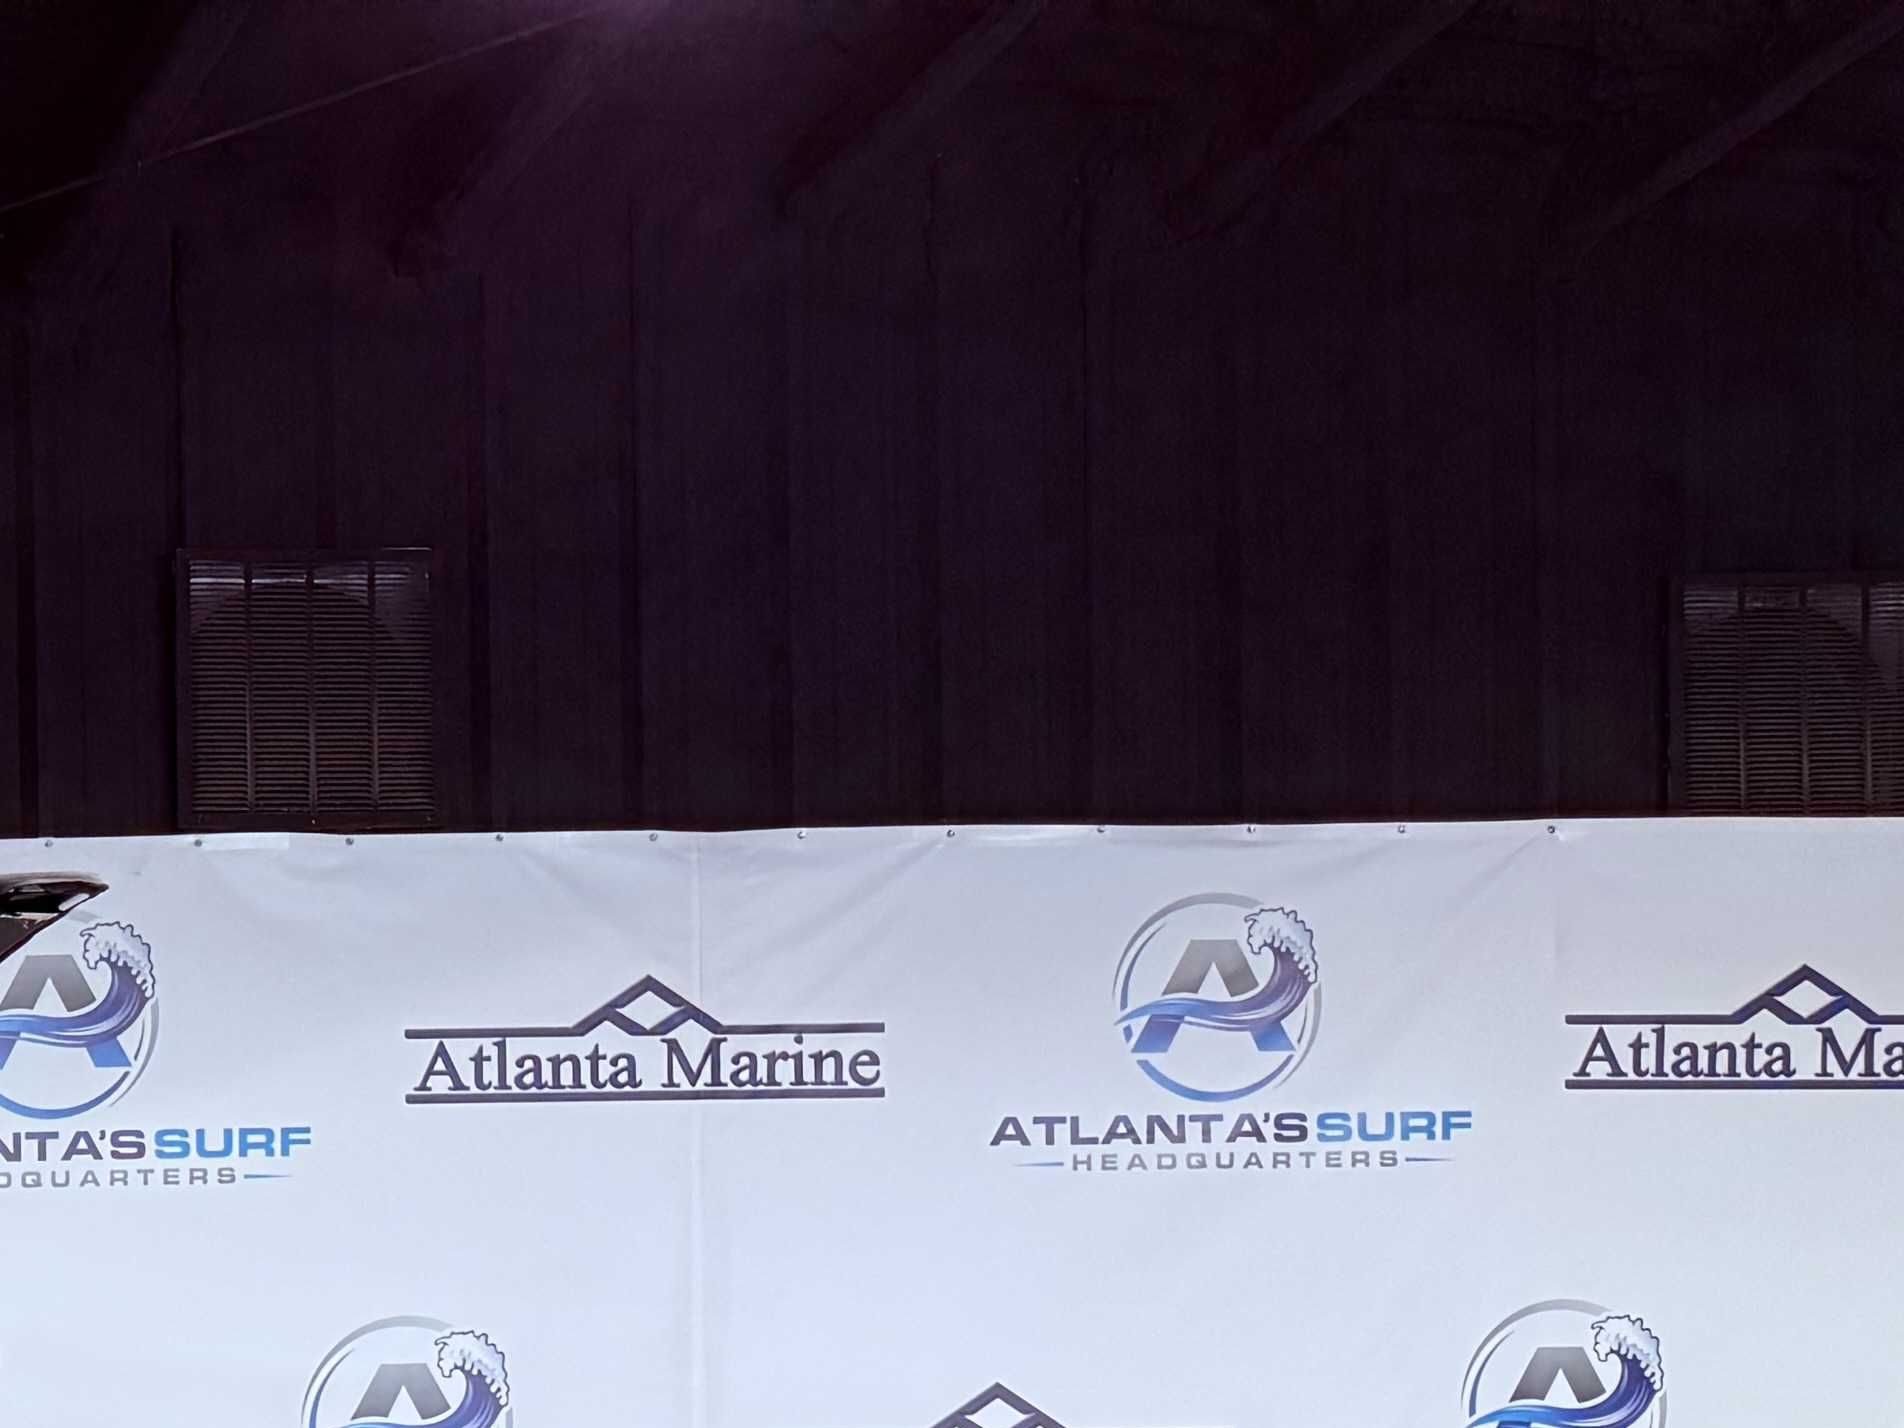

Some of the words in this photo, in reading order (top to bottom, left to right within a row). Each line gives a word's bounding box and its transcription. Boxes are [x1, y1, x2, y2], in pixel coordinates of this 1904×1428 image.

[413, 1037, 643, 1092] Atlanta
[658, 1036, 880, 1091] Marine
[1572, 1025, 1797, 1078] Atlanta
[1073, 1151, 1397, 1171] HEADQUARTERS
